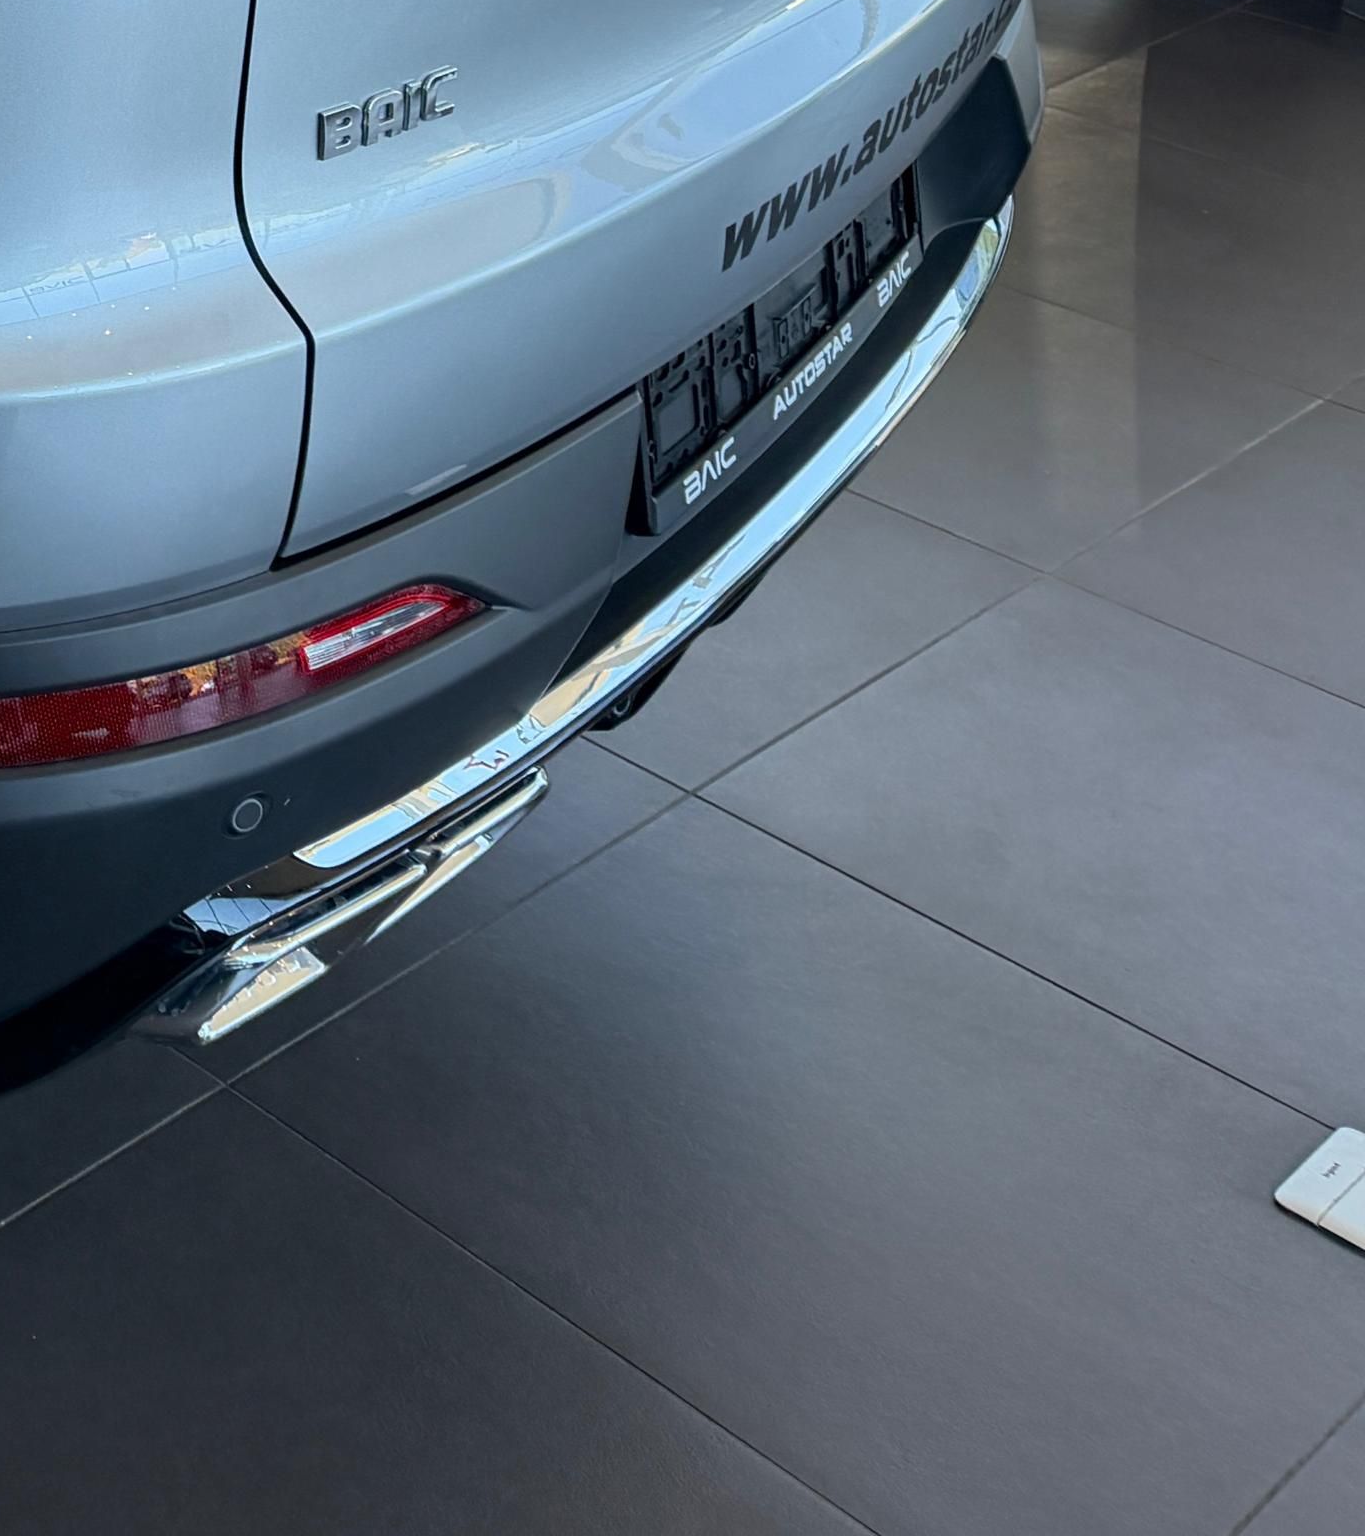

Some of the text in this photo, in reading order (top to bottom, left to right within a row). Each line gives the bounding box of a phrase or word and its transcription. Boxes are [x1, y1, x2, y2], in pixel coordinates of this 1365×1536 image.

[316, 65, 458, 161] BAIC
[683, 250, 913, 505] BAIC AUTOSTAR BAIC
